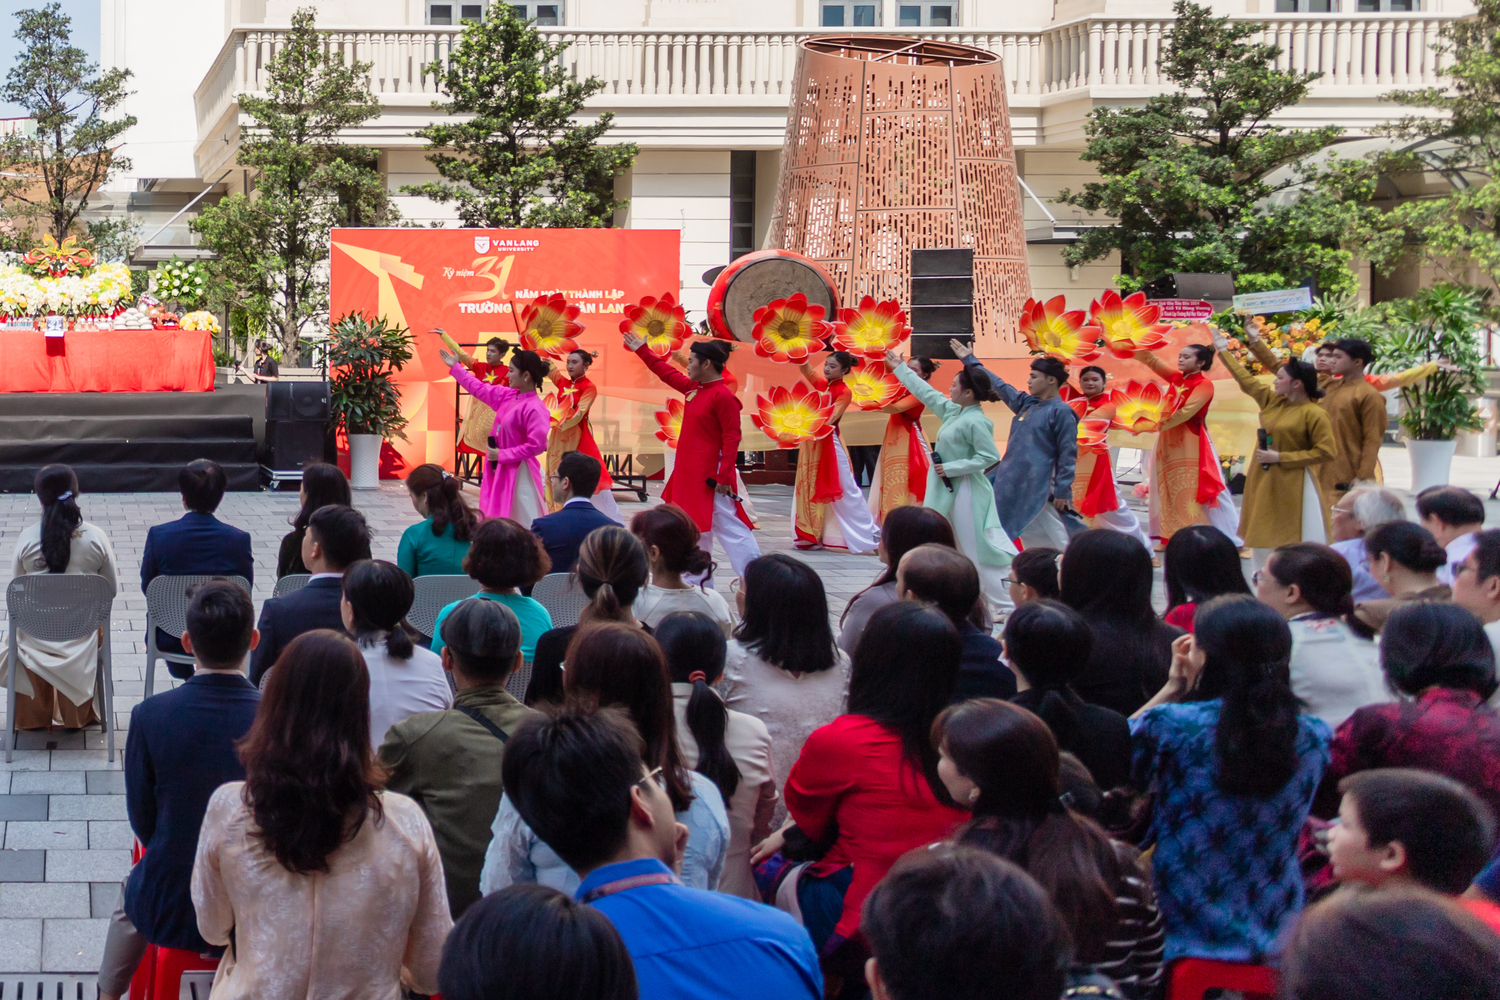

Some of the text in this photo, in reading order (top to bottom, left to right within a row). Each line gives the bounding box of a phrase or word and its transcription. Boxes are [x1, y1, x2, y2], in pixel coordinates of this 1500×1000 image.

[455, 254, 516, 304] 31
[515, 288, 625, 300] NĂM NGY THÀNH LẬP
[458, 300, 512, 314] TRƯỜNG
[569, 301, 596, 313] ĂN
[599, 302, 631, 314] LAN
